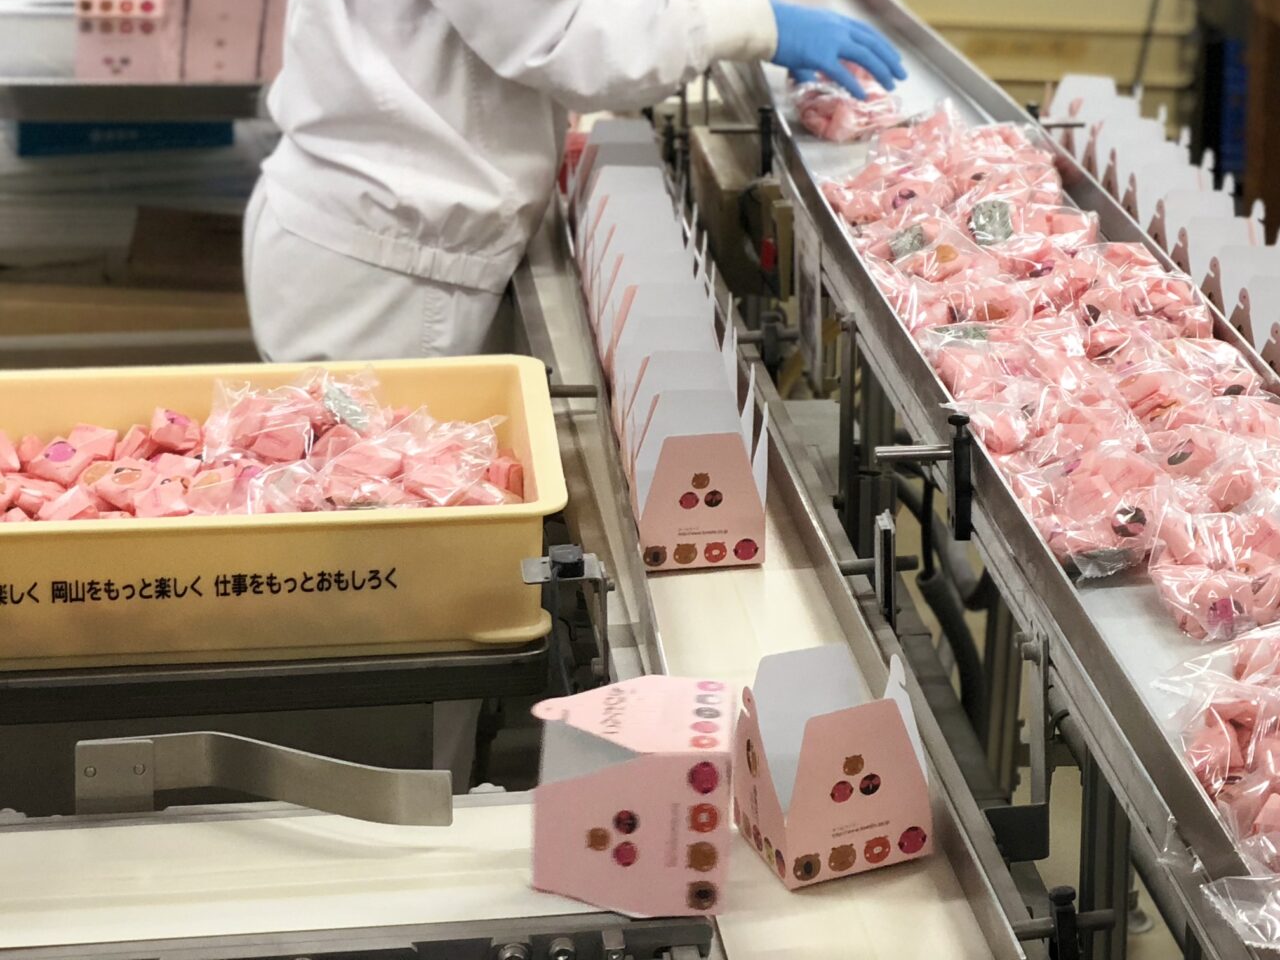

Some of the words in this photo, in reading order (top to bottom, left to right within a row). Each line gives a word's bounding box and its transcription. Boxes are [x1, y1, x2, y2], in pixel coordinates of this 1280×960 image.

[51, 575, 203, 604] 岡山をもっと楽しく
[213, 567, 399, 598] 仕事をもっとおもしろく
